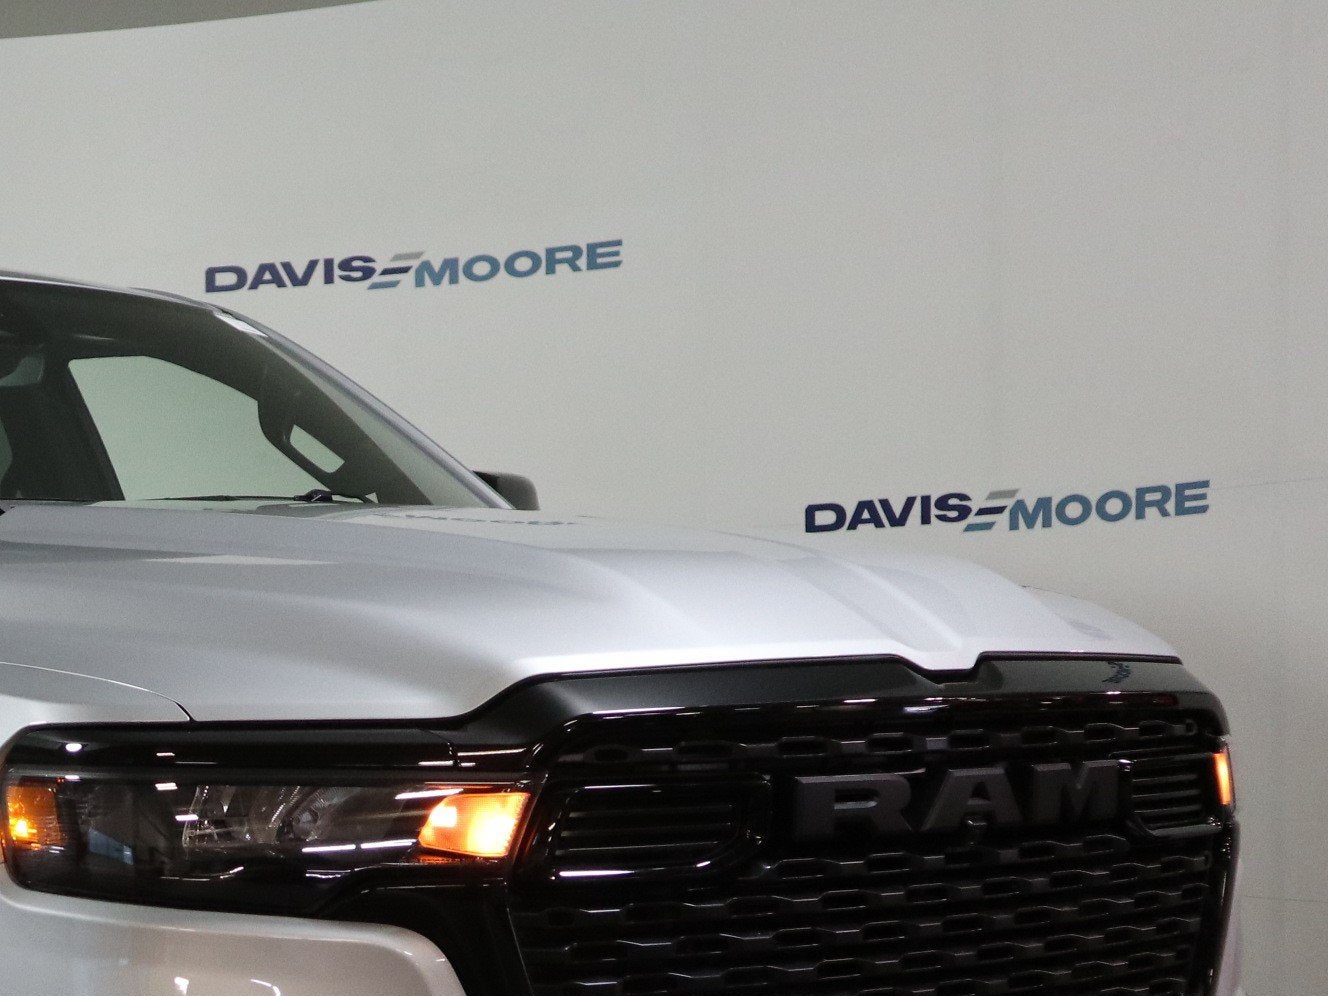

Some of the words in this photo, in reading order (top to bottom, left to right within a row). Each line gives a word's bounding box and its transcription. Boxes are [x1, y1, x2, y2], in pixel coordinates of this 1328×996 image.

[205, 255, 377, 293] DAVIS
[415, 239, 623, 288] MOORE
[805, 492, 972, 533] DAVIS
[1008, 479, 1211, 532] MOORE
[793, 759, 1120, 842] RAM
